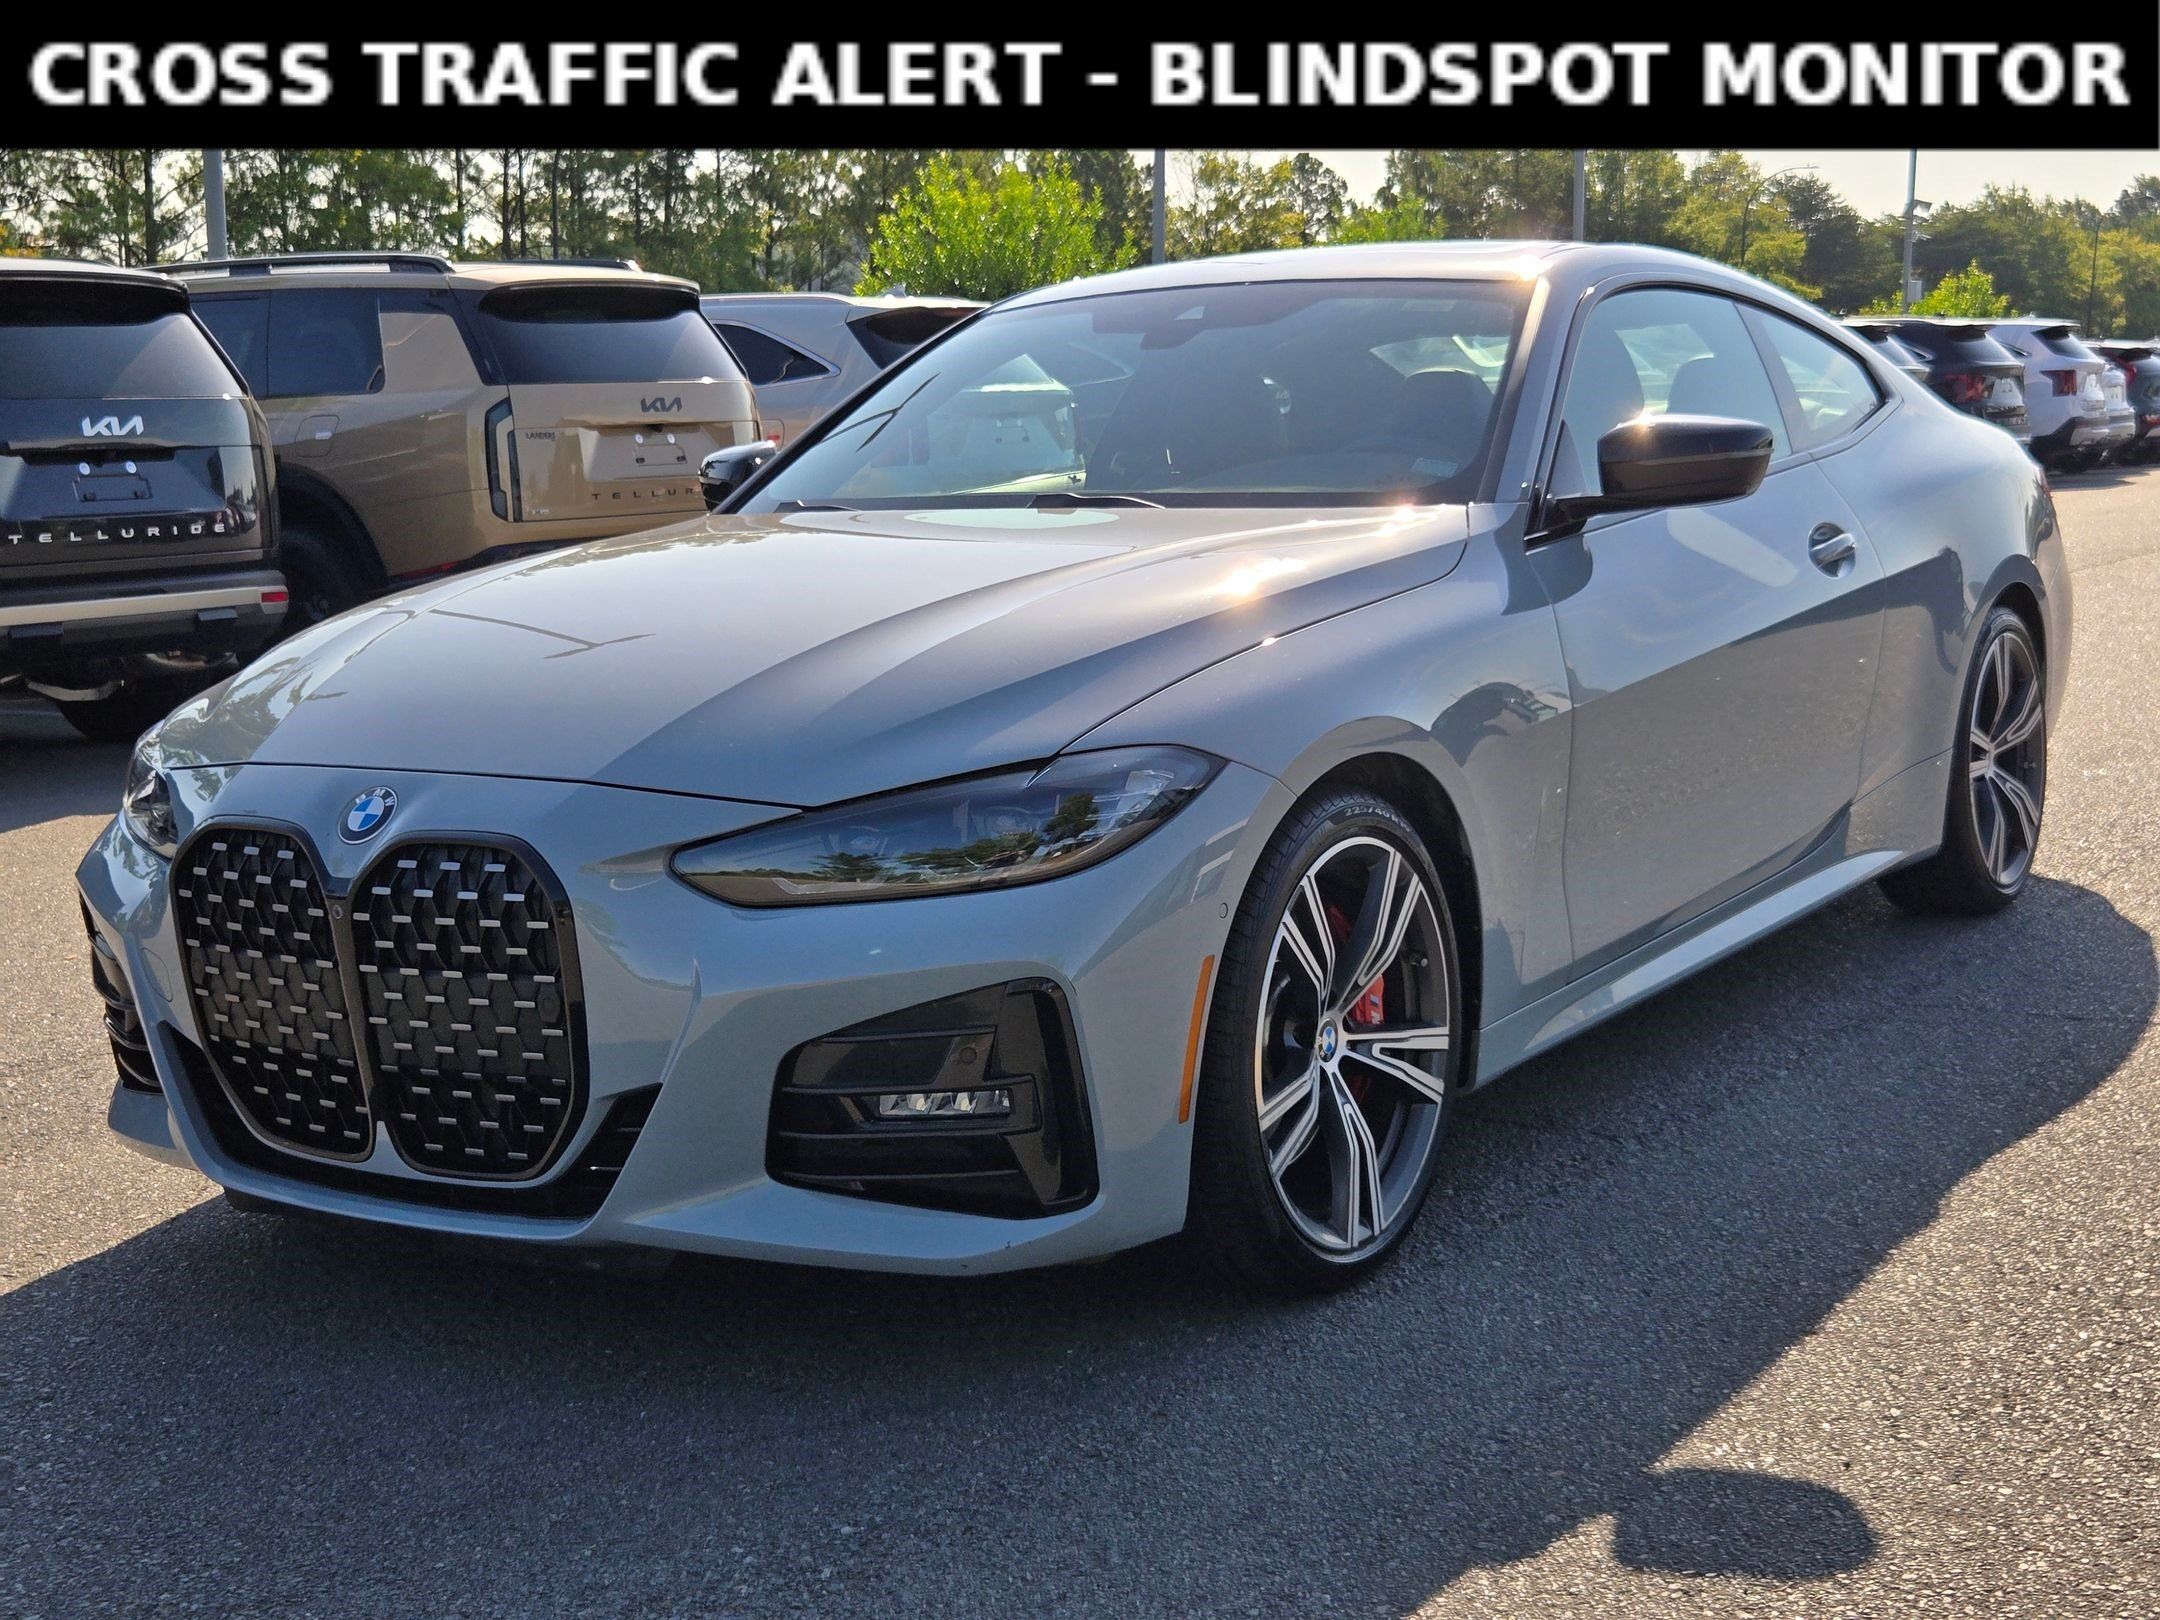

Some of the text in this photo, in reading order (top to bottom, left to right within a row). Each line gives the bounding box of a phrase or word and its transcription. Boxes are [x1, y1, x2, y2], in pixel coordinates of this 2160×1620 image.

[640, 397, 682, 413] KIA
[81, 415, 144, 437] KIA
[591, 487, 694, 501] TELLUR
[8, 523, 226, 545] TELLURIDE
